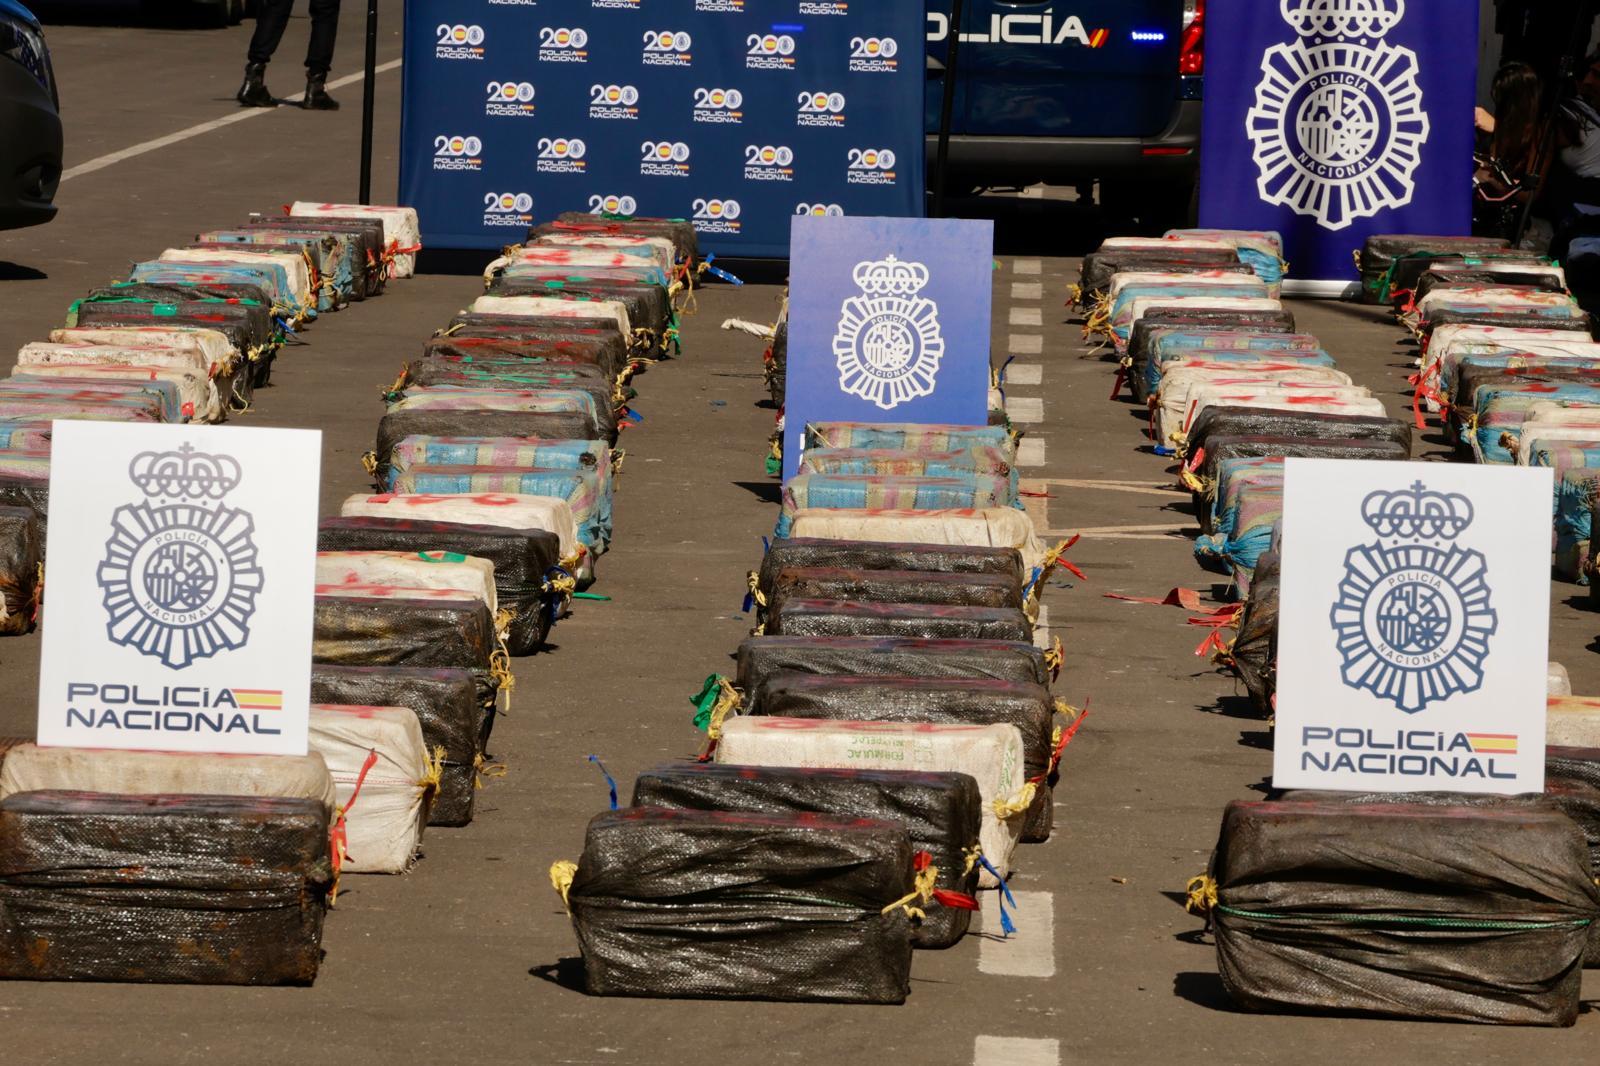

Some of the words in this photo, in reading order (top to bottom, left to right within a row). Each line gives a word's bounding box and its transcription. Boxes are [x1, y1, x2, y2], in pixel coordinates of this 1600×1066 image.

[1309, 74, 1369, 93] POLICÍA
[745, 173, 793, 181] NACIONAL
[1297, 152, 1376, 178] NACIONAL
[863, 362, 912, 379] NACIONAL
[143, 600, 216, 624] NACIONAL
[1377, 642, 1449, 666] NACIONAL
[66, 708, 281, 735] NACIONAL
[848, 749, 904, 760] FORMULAC
[1301, 751, 1517, 779] NACIONAL
